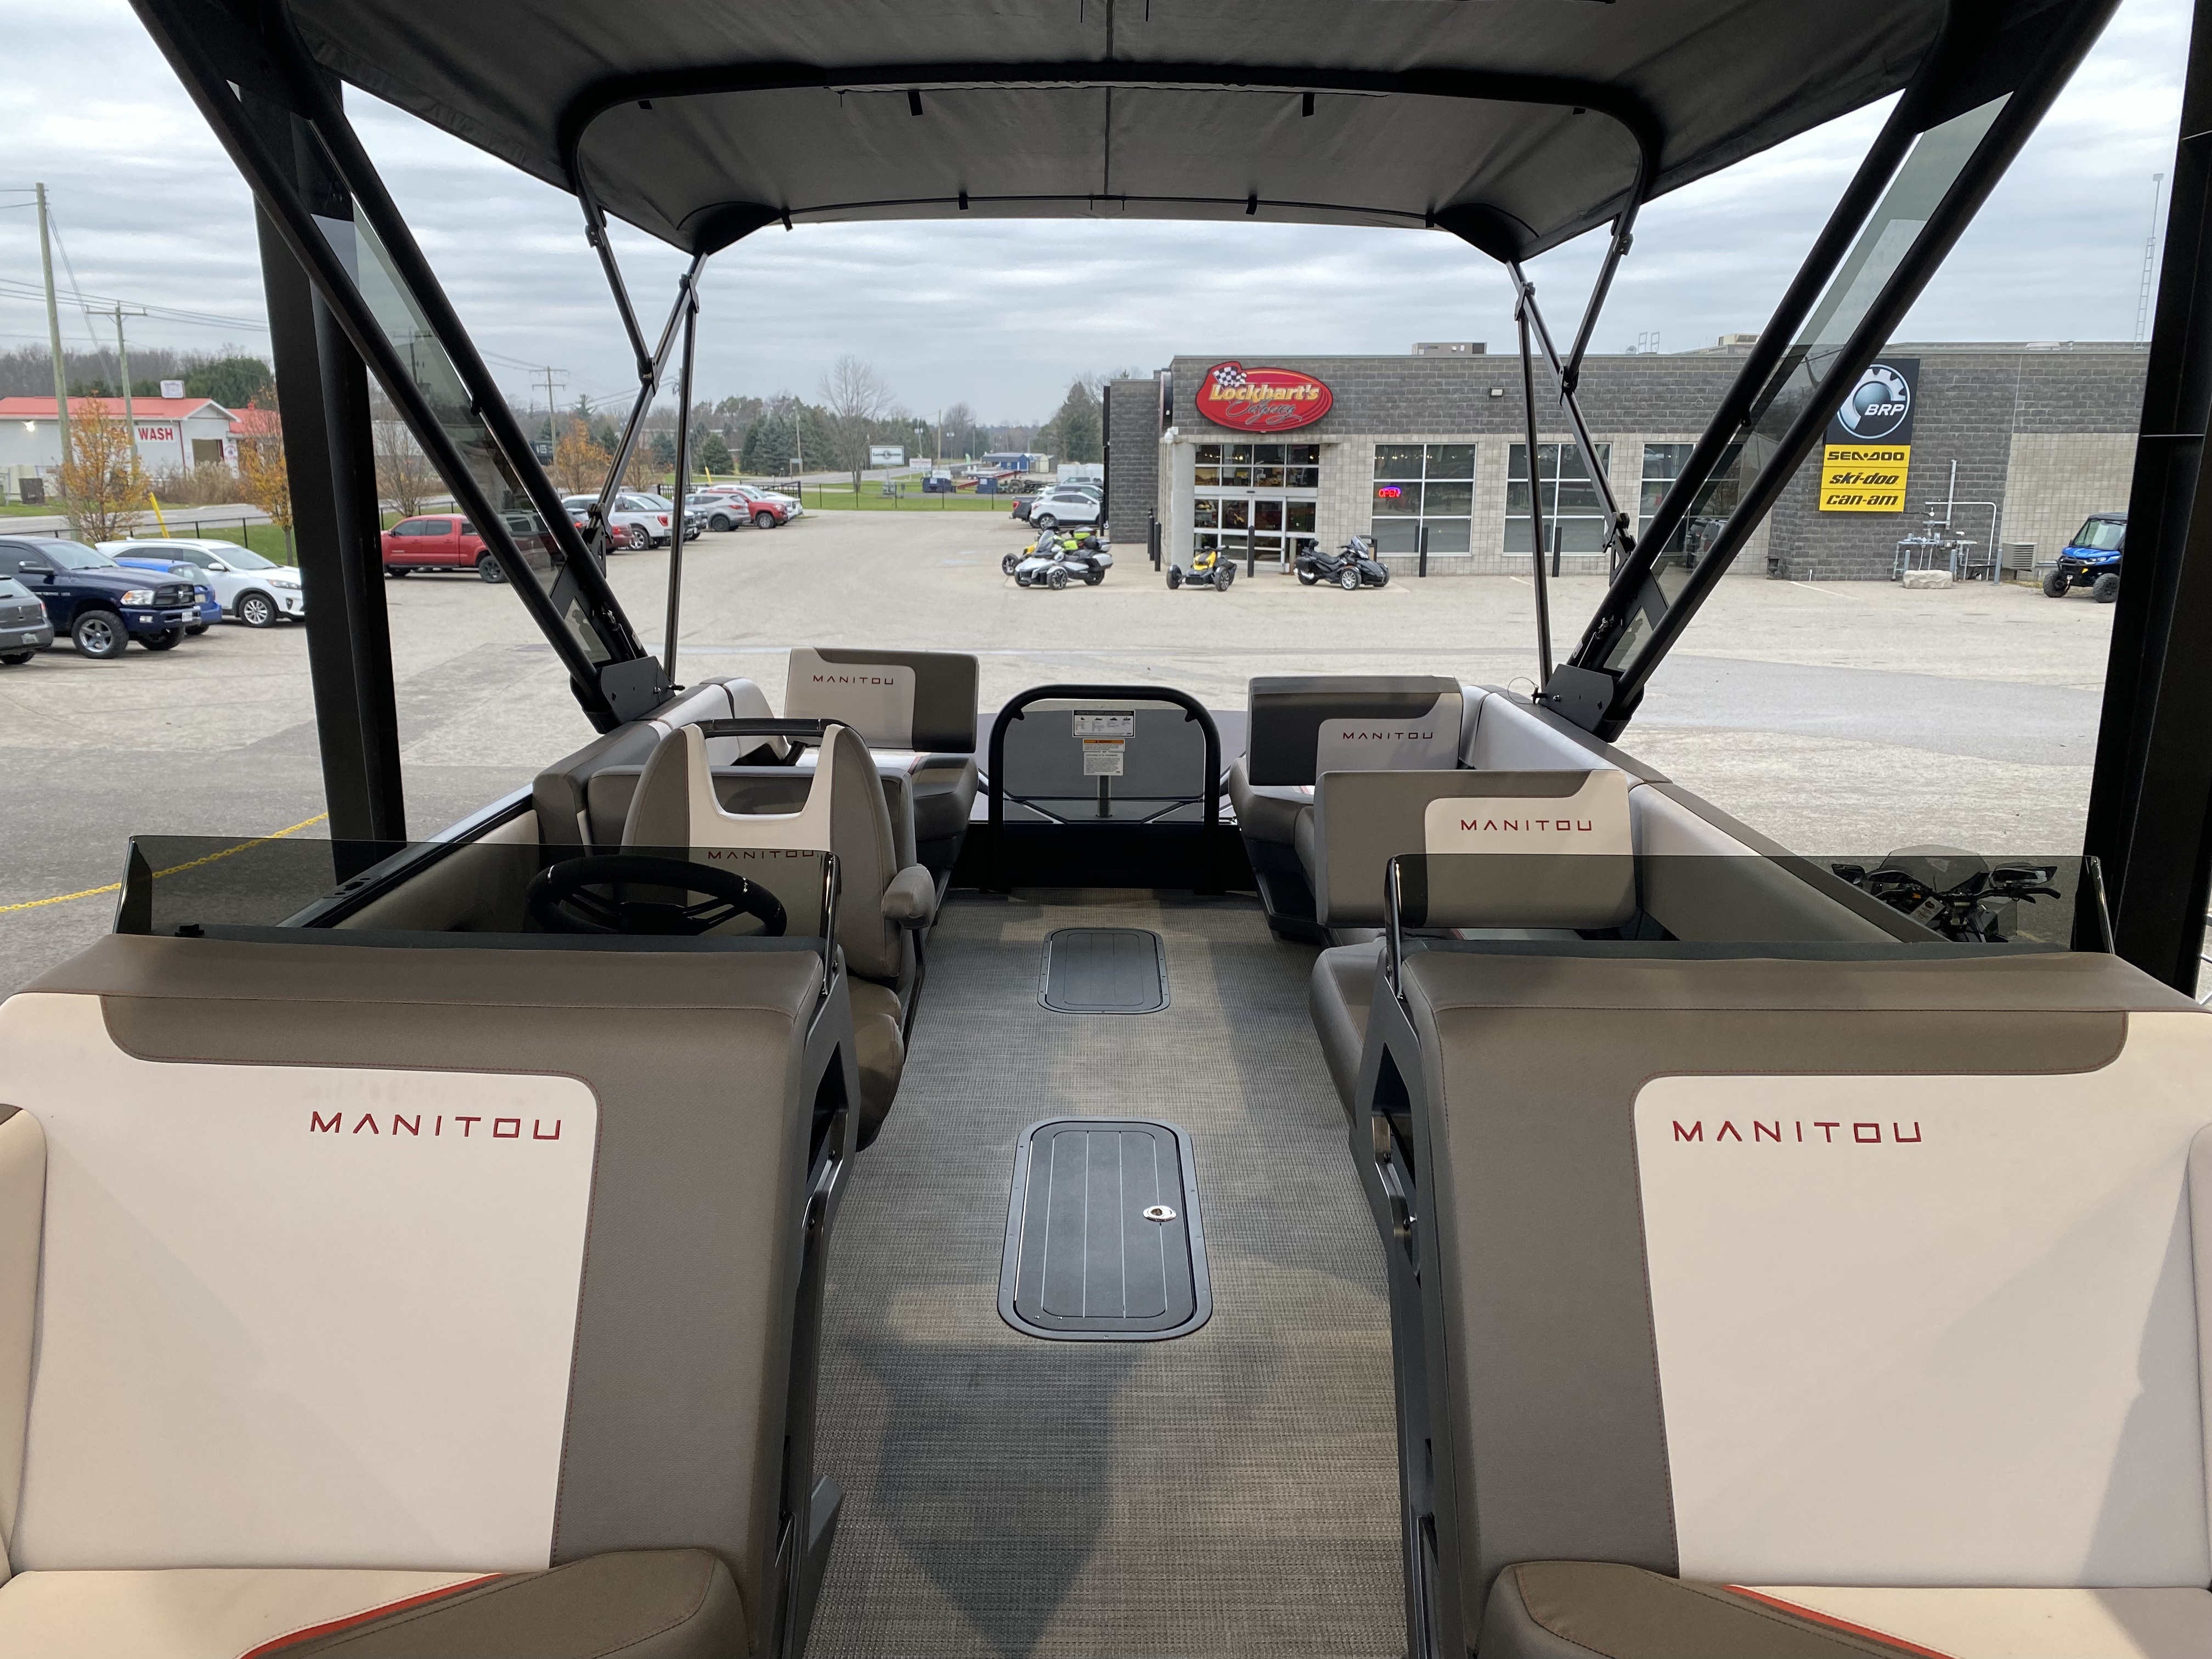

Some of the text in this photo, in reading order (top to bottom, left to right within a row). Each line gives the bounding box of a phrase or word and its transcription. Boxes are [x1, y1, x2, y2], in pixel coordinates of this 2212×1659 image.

[1209, 383, 1321, 402] Lockhart's
[1865, 403, 1905, 416] BRP
[138, 427, 173, 441] WASH
[1829, 472, 1900, 484] ski-doo
[1379, 488, 1400, 498] OPEN
[1826, 494, 1899, 506] can-am
[813, 675, 894, 685] MANITOU
[1460, 819, 1592, 831] MANITOU
[708, 850, 814, 859] MANITOU
[310, 1111, 561, 1141] MANITOU
[1672, 1121, 1922, 1143] MANITOU
